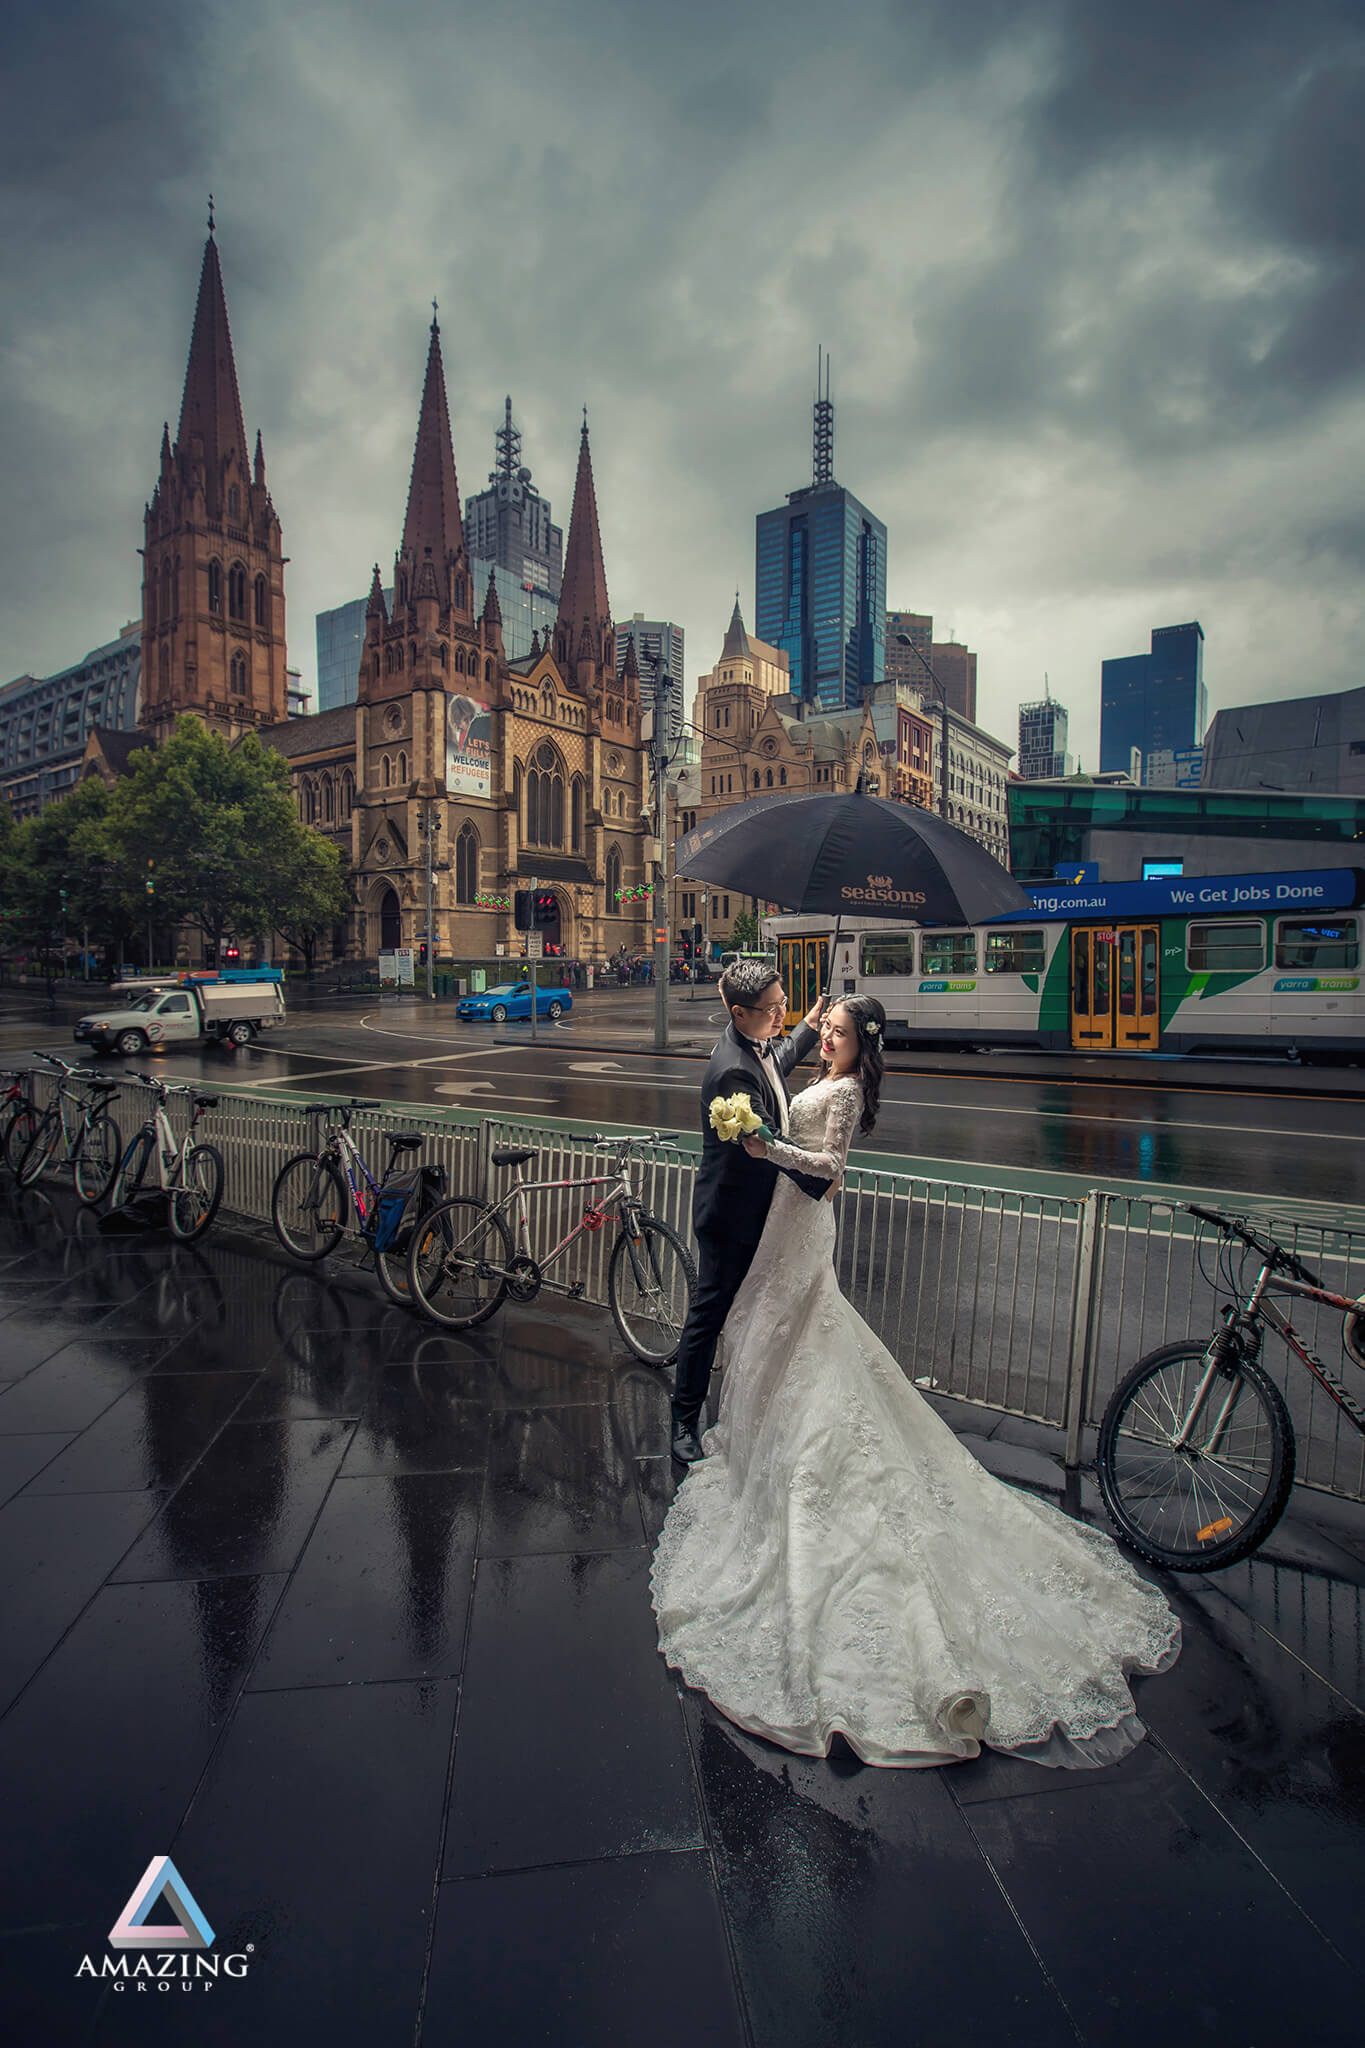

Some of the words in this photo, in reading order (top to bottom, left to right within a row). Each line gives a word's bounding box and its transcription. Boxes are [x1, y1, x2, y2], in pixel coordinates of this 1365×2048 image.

[468, 737, 490, 750] LET'S
[465, 747, 490, 760] FULLY
[453, 754, 490, 770] WELCOME
[450, 764, 490, 780] REFUGEES
[841, 886, 926, 904] seasons
[1170, 889, 1195, 903] We
[1199, 888, 1228, 902] Get
[1231, 886, 1270, 903] Jobs
[1276, 885, 1324, 899] Done
[1029, 896, 1106, 912] ing.com.au
[1097, 931, 1116, 941] STOP
[1280, 981, 1309, 990] yarra
[1319, 980, 1353, 988] trams
